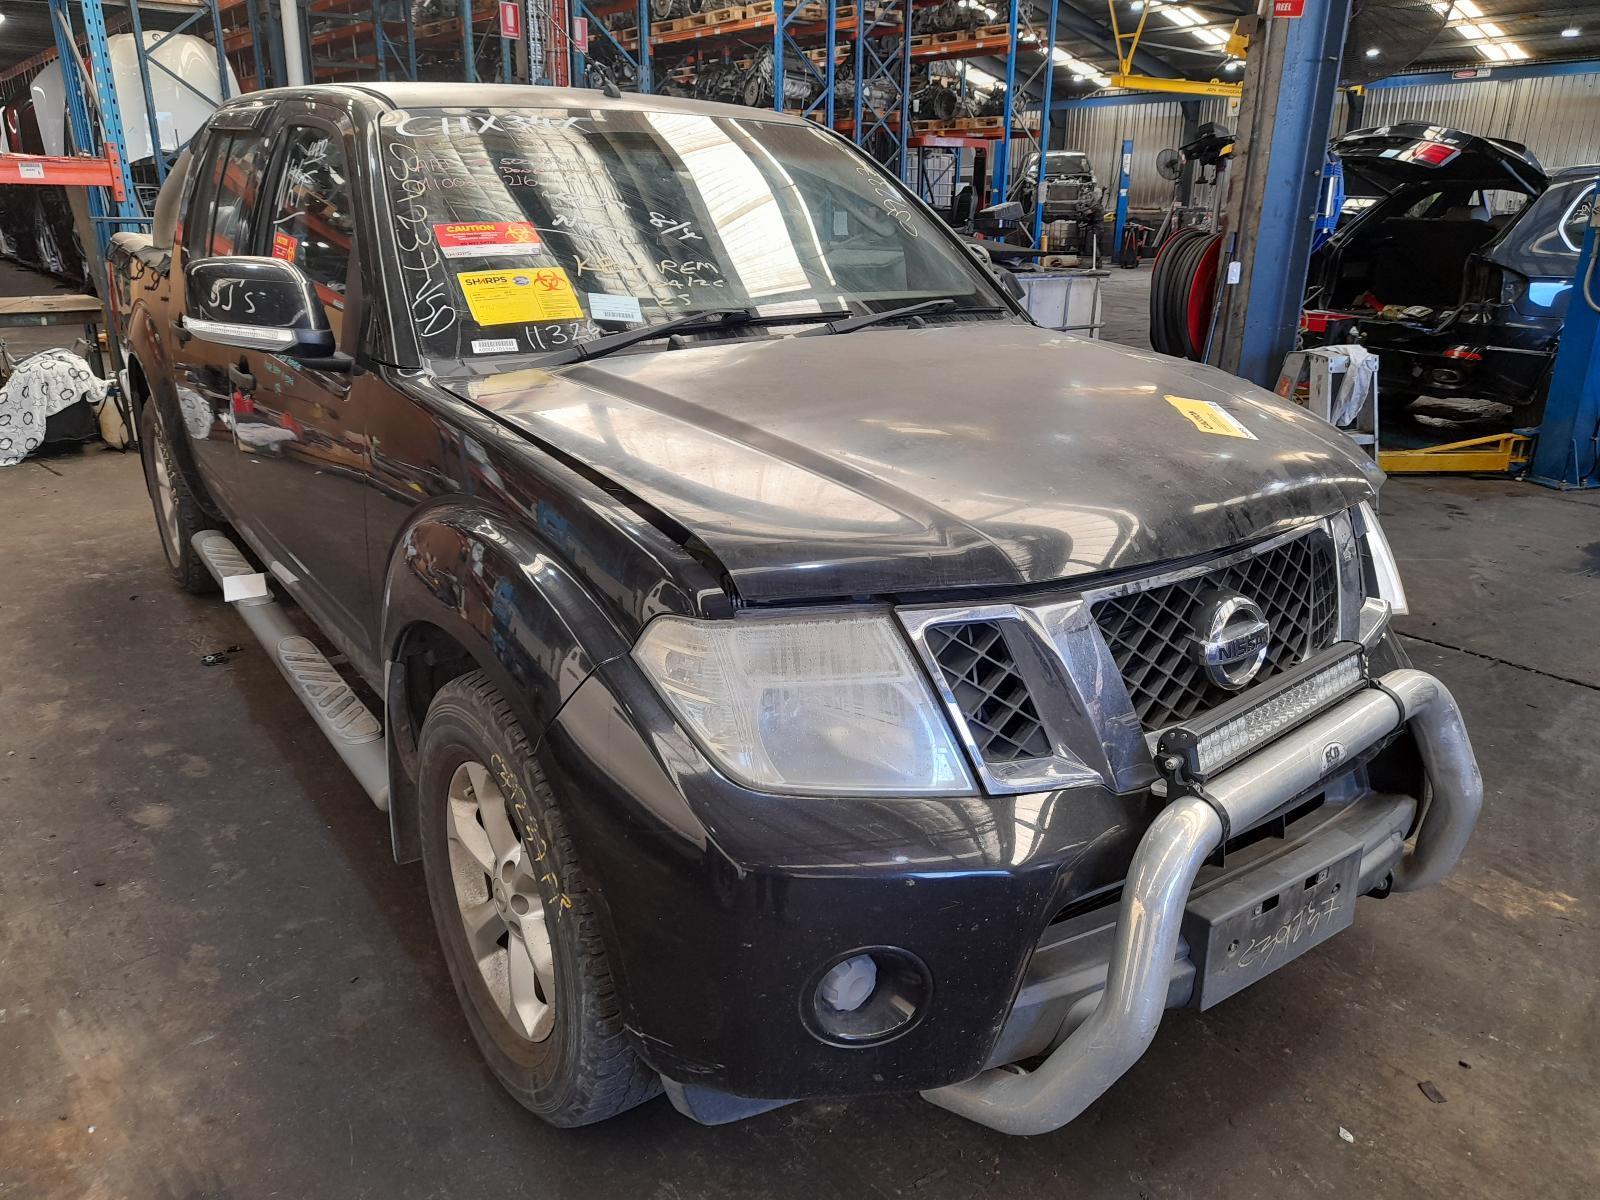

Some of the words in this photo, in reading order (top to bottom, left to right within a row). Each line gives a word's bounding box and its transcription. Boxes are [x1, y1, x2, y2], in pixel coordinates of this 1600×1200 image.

[1276, 2, 1292, 11] REEL
[446, 224, 497, 233] CAUTION
[465, 276, 508, 286] SHARPS
[1218, 634, 1265, 661] NISSAN
